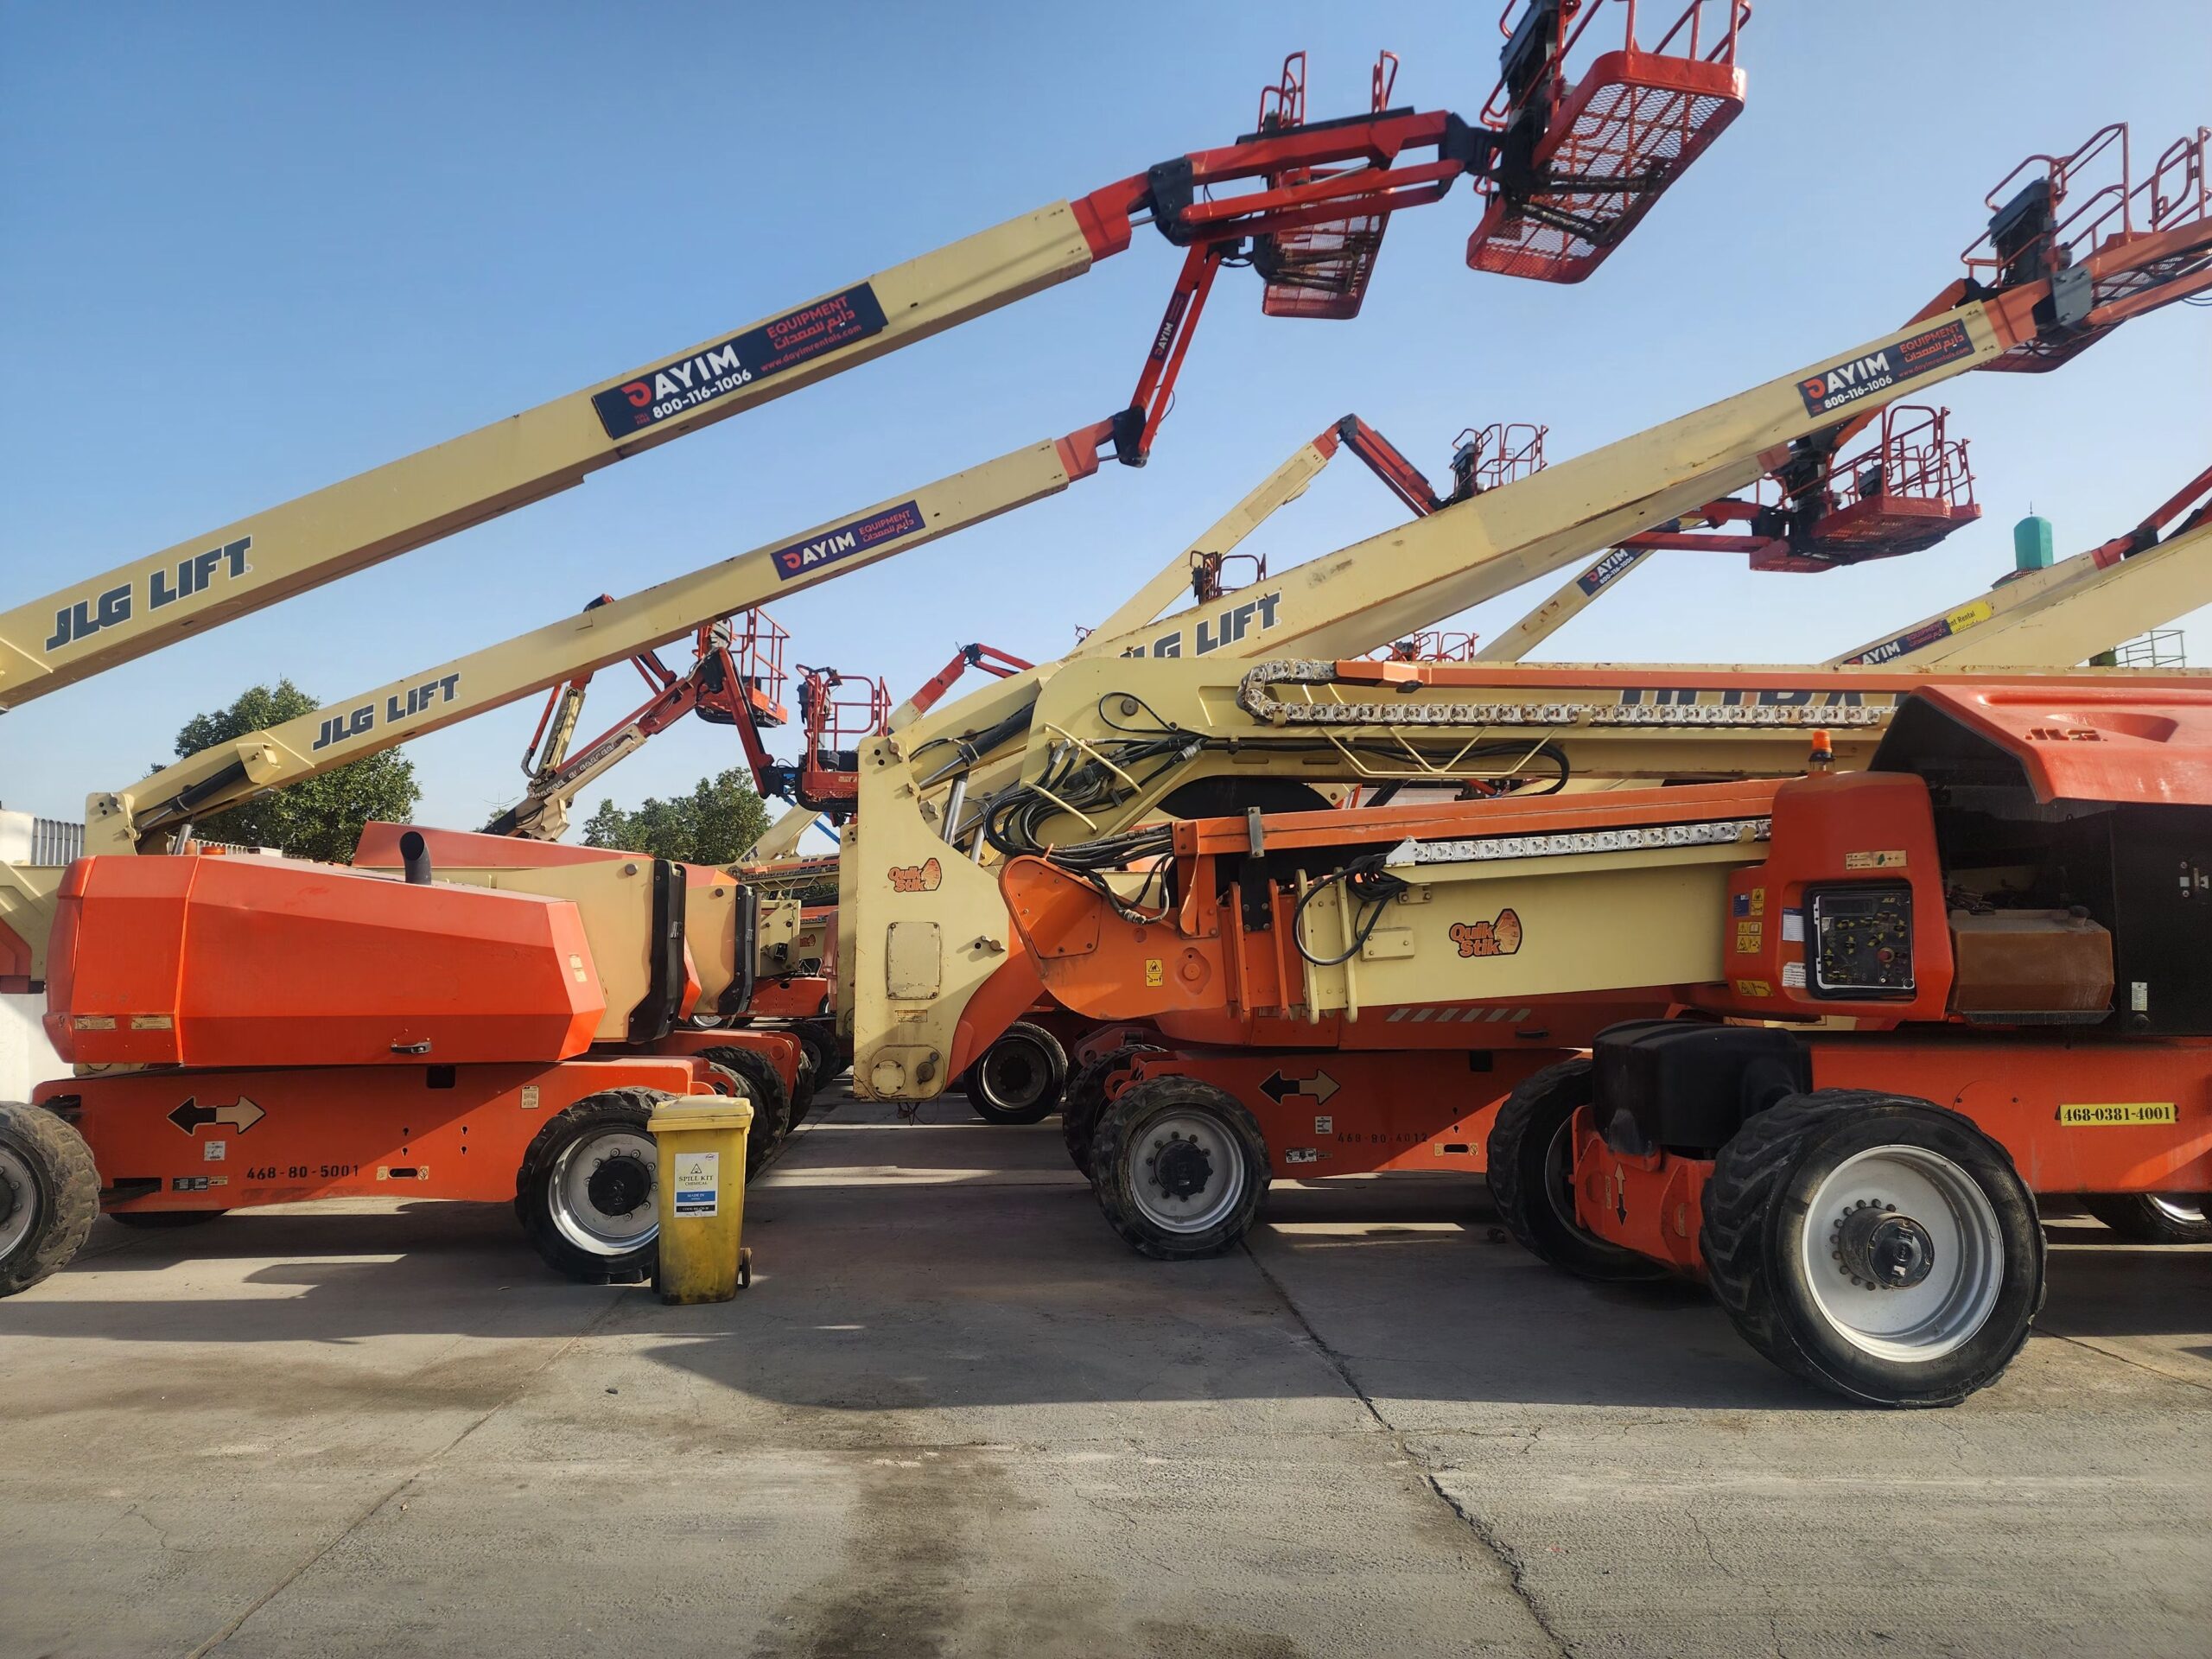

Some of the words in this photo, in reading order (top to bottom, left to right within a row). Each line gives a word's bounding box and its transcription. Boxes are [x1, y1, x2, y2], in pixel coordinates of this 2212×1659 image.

[766, 296, 848, 339] EQUIPMENT
[826, 308, 855, 334] دايم
[760, 324, 862, 372] www.dayimrentals.com
[773, 321, 825, 350] للمعدات
[1899, 323, 1960, 353] EQUIPMENT
[1943, 334, 1965, 353] دايم
[1904, 342, 1942, 363] للمعدات
[621, 344, 741, 408] DAYIM
[1803, 353, 1891, 399] DAYIM
[652, 368, 752, 420] 800-116-1006
[1824, 376, 1892, 410] 800-116-1006
[858, 510, 910, 535] EQUIPMENT
[862, 525, 895, 543] للمعدات
[896, 518, 914, 533] دايم
[782, 531, 856, 569] DAYIM
[1599, 556, 1635, 585] 800-116-1006
[45, 582, 131, 652] JLG
[149, 535, 252, 612] LIFT
[1196, 590, 1281, 658] LIFT
[1957, 610, 1976, 623] Rental
[312, 703, 374, 752] JLG
[386, 673, 460, 724] LIFT
[2023, 728, 2101, 741] JLG
[888, 867, 922, 882] Quik
[894, 879, 925, 892] Stik
[1450, 922, 1495, 943] Quik
[1459, 938, 1501, 957] Stik
[2063, 1107, 2171, 1122] 468-0381-4001
